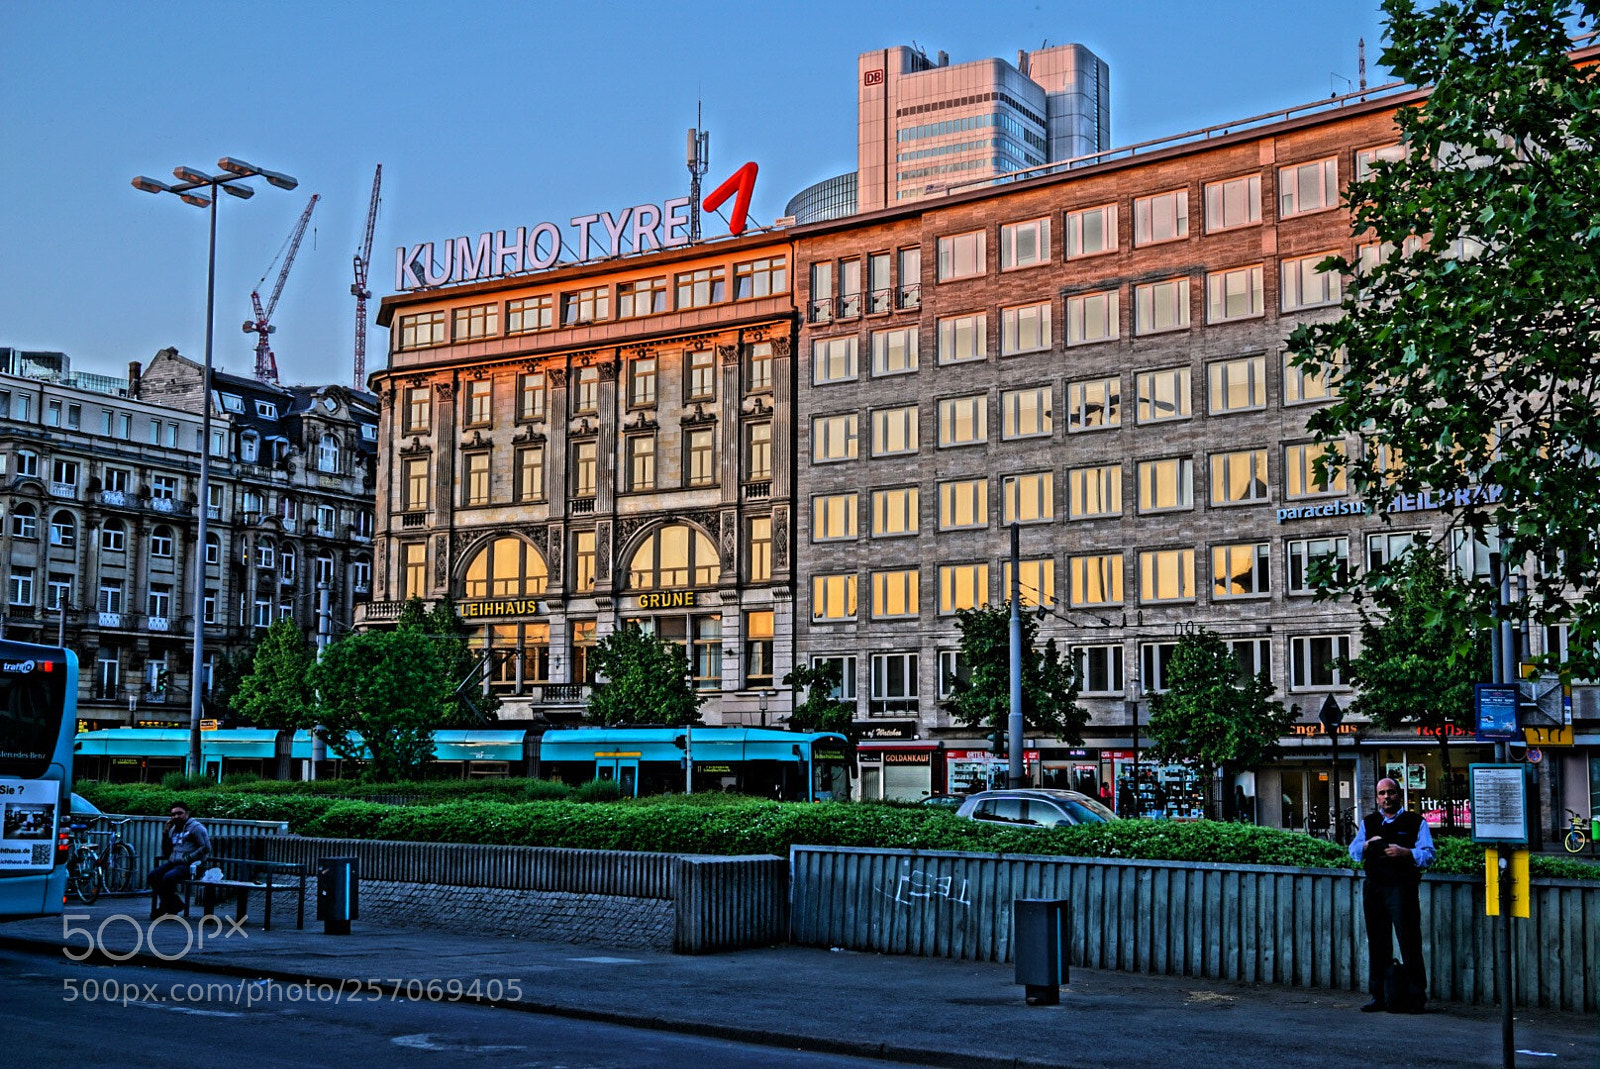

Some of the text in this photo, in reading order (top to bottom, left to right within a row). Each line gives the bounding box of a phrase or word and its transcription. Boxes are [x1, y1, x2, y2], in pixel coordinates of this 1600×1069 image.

[866, 71, 882, 85] DB
[395, 196, 690, 291] KUMHO TYRE
[638, 590, 694, 608] GRÜNE
[460, 600, 537, 617] LEIHHAUS
[885, 754, 929, 762] GOLDANKAUF
[0, 784, 24, 795] Sie ?
